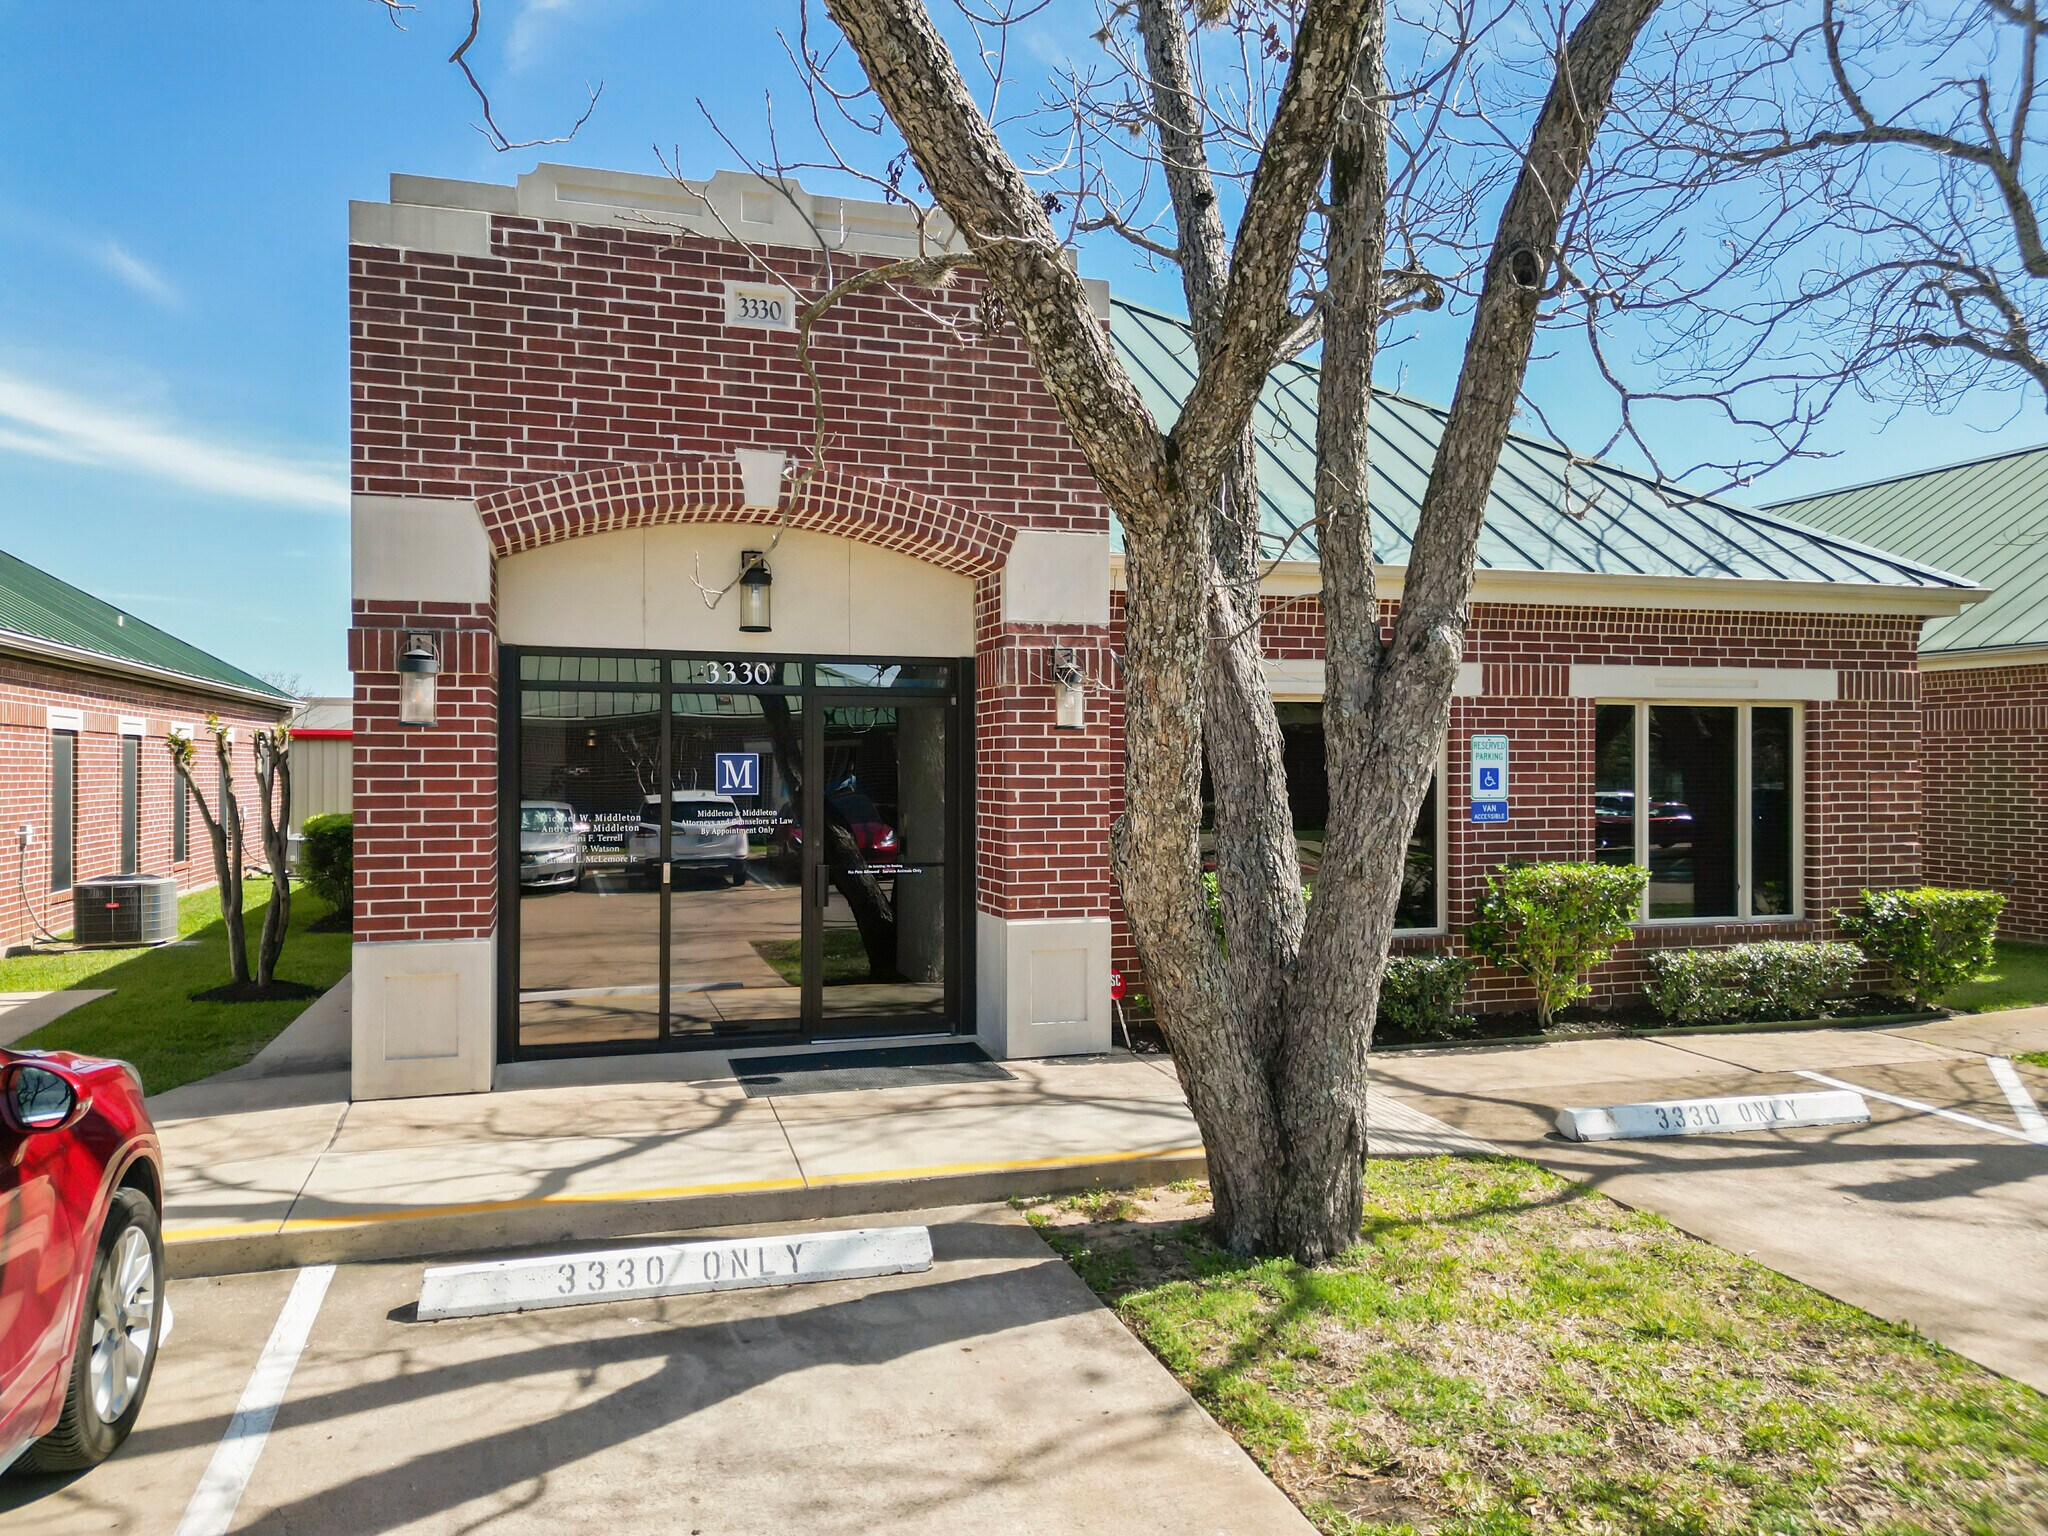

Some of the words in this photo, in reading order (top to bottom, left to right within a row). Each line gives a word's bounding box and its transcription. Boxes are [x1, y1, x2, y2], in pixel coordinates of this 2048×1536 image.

[737, 297, 782, 320] 3330
[705, 661, 771, 685] 3330
[1473, 741, 1505, 750] RESERVED
[722, 760, 753, 788] M
[1482, 804, 1497, 812] VAN
[579, 813, 592, 822] W.
[594, 813, 642, 822] Middleton
[742, 809, 778, 817] Middleton
[780, 817, 794, 825] Law
[593, 823, 640, 832] Middleton
[701, 828, 710, 836] By
[711, 827, 757, 836] Appointment
[758, 826, 775, 835] Only
[588, 834, 595, 842] F.
[597, 834, 623, 842] Terrell
[581, 845, 588, 853] P.
[590, 845, 620, 853] Watson
[585, 855, 628, 863] McLemore
[1654, 1104, 1720, 1131] 3330
[1737, 1099, 1798, 1123] ONLY
[557, 1255, 664, 1295] 3330
[703, 1243, 802, 1280] ONLY
